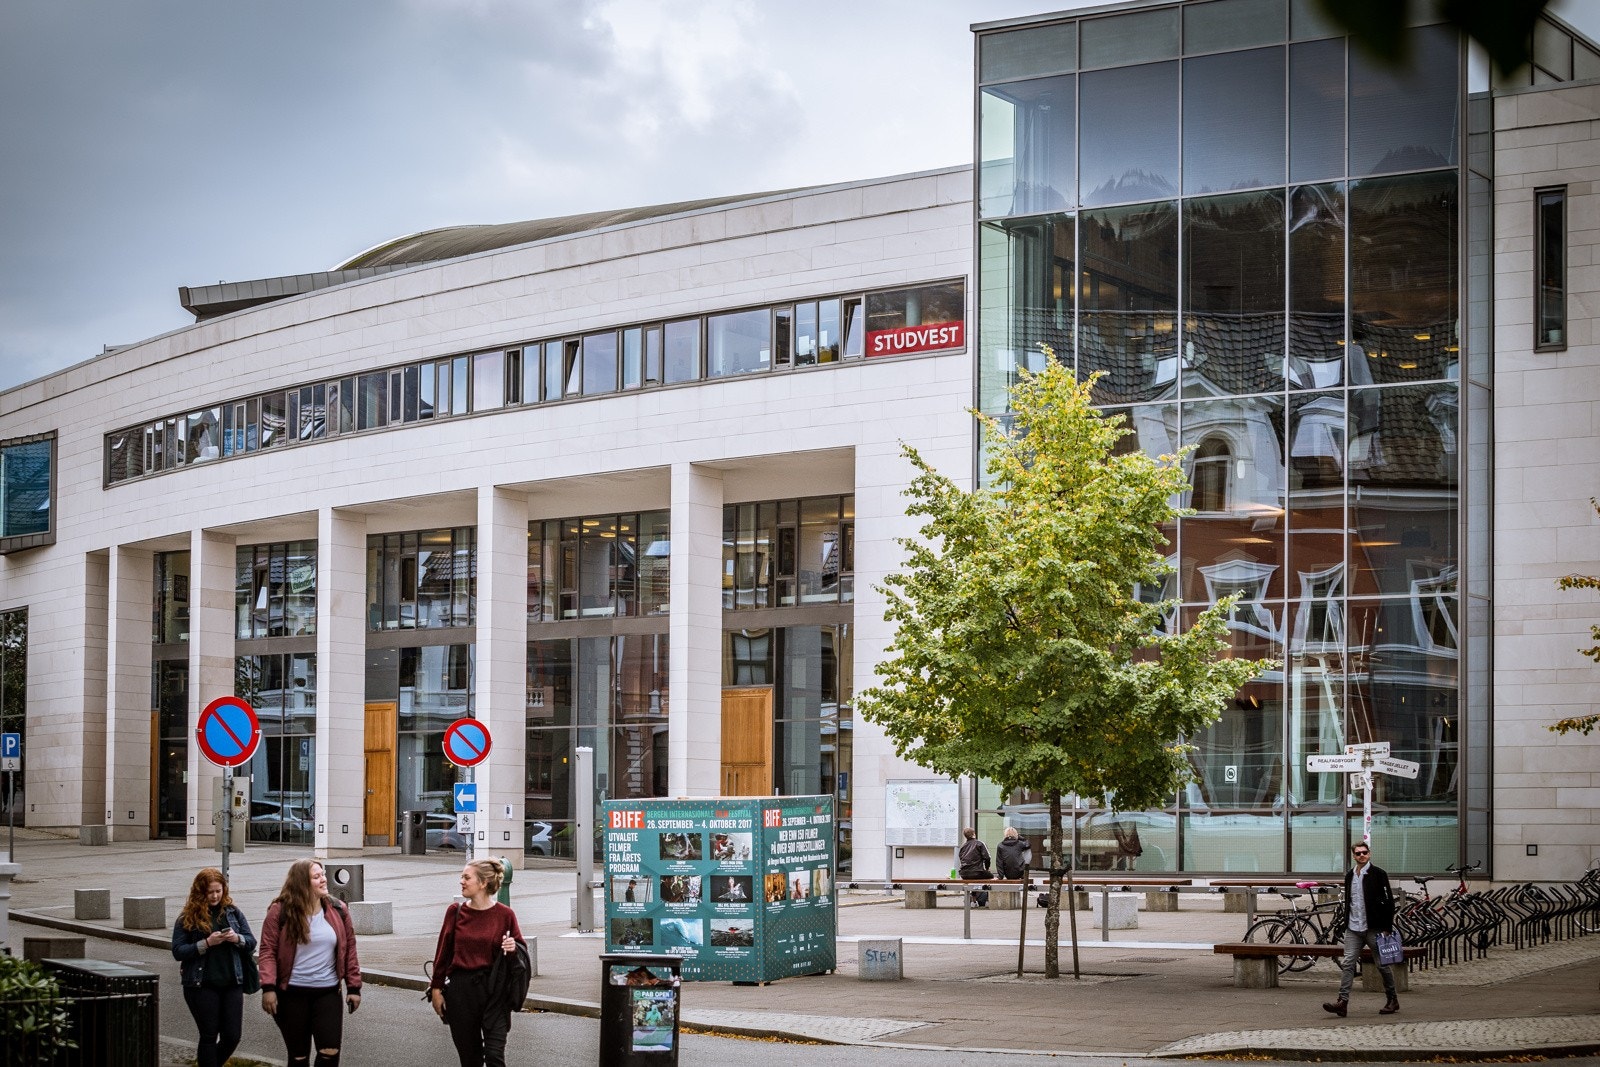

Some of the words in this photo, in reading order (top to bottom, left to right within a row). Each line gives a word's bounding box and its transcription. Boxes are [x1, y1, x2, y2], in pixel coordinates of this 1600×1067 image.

[874, 326, 959, 352] STUDVEST
[6, 736, 16, 755] P
[612, 811, 642, 828] BIFF
[647, 810, 668, 818] BERGEN
[669, 810, 714, 818] INTERNASJONALE
[765, 809, 781, 827] BIFF
[647, 820, 657, 829] 26.
[658, 820, 694, 829] SEPTEMBER
[701, 820, 708, 829] 4.
[709, 820, 737, 829] OKTOBER
[738, 820, 752, 829] 2017
[608, 833, 638, 842] UTVALGTE
[805, 828, 818, 839] FILMER
[609, 843, 631, 852] FILMER
[770, 841, 776, 854] PÅ
[777, 842, 787, 854] OVER
[796, 839, 826, 852] FORESTILLINGER
[609, 854, 621, 862] FRA
[622, 851, 641, 862] ÅRETS
[609, 864, 640, 873] PROGRAM
[865, 949, 897, 962] STEM
